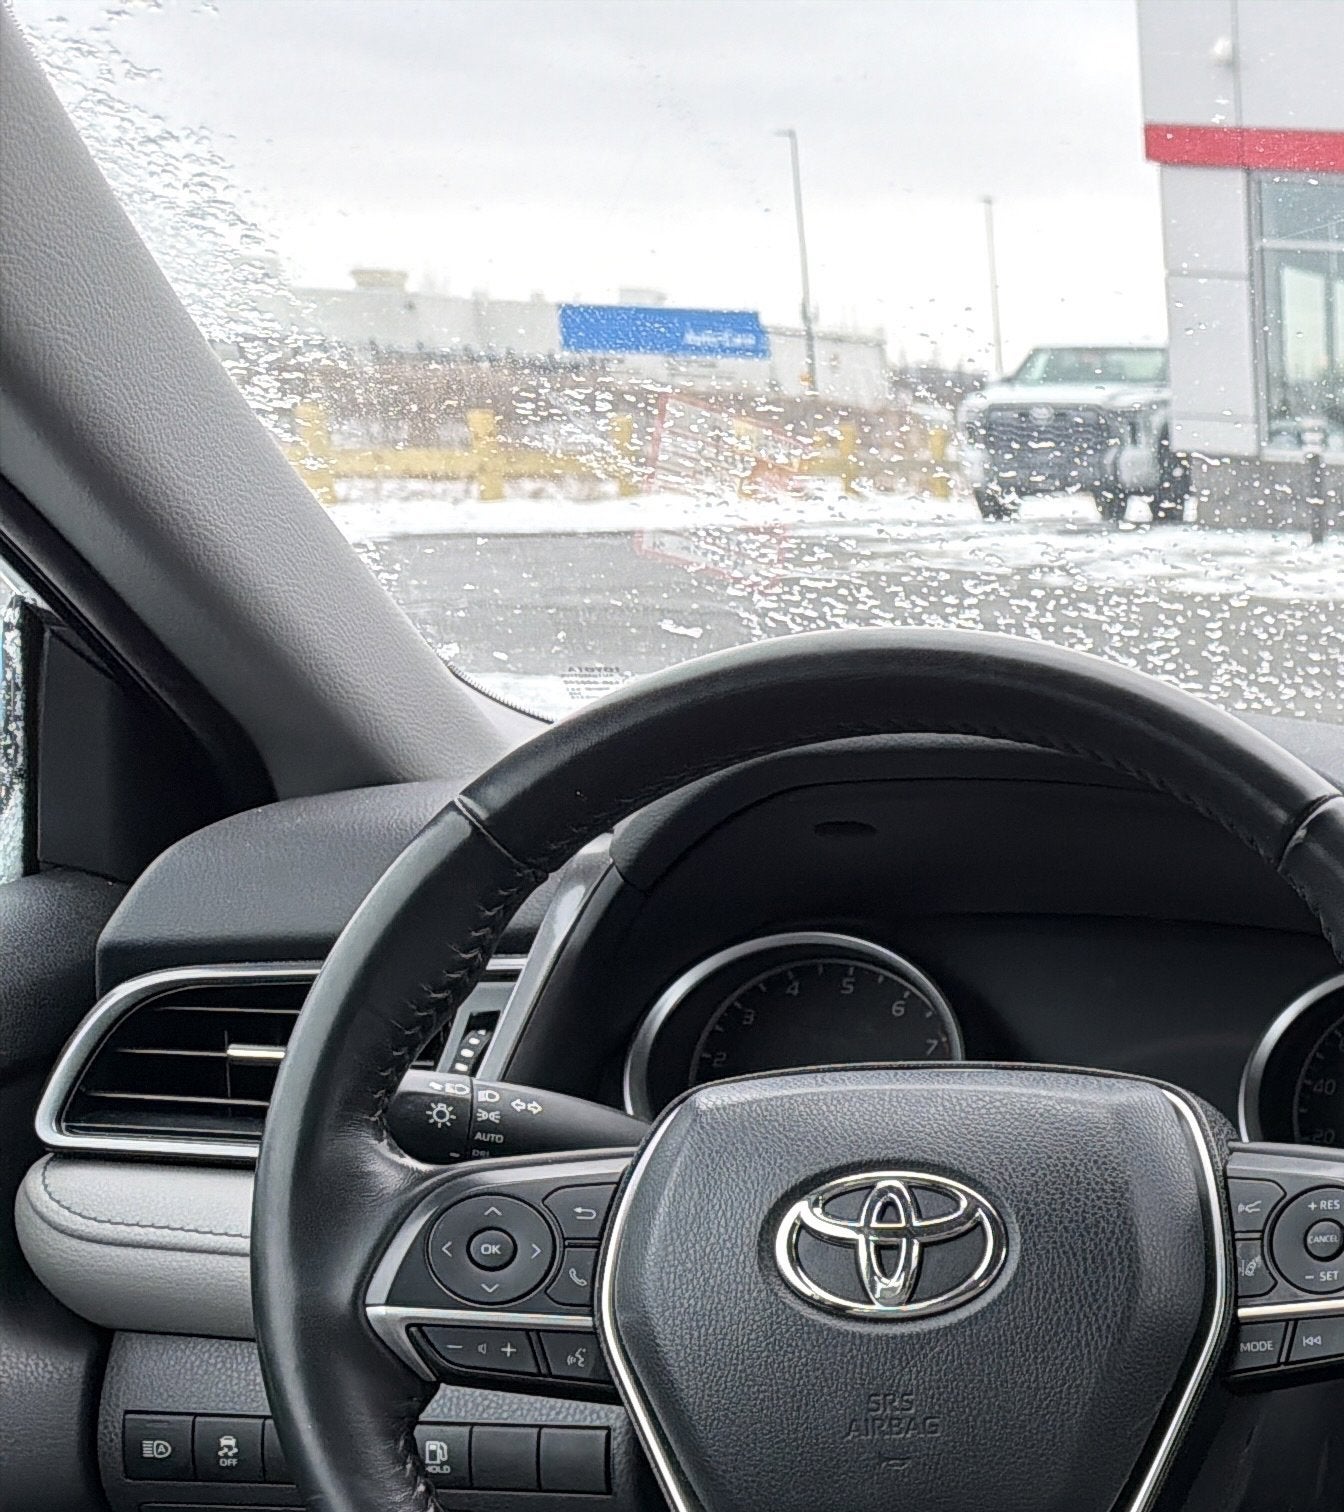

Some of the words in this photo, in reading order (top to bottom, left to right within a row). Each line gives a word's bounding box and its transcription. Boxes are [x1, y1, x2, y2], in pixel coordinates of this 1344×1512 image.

[785, 980, 800, 996] 4
[840, 978, 855, 995] 5
[891, 1000, 905, 1017] 6
[743, 1009, 755, 1026] 3
[925, 1039, 939, 1056] 7
[474, 1132, 504, 1144] AUTO
[1320, 1200, 1341, 1211] RES
[1308, 1235, 1339, 1244] CANCEL
[480, 1243, 502, 1255] OK
[1319, 1271, 1340, 1282] SET
[1239, 1340, 1274, 1353] MODE
[868, 1393, 915, 1415] SRS
[845, 1416, 941, 1440] AIRBAG
[219, 1458, 238, 1467] OFF
